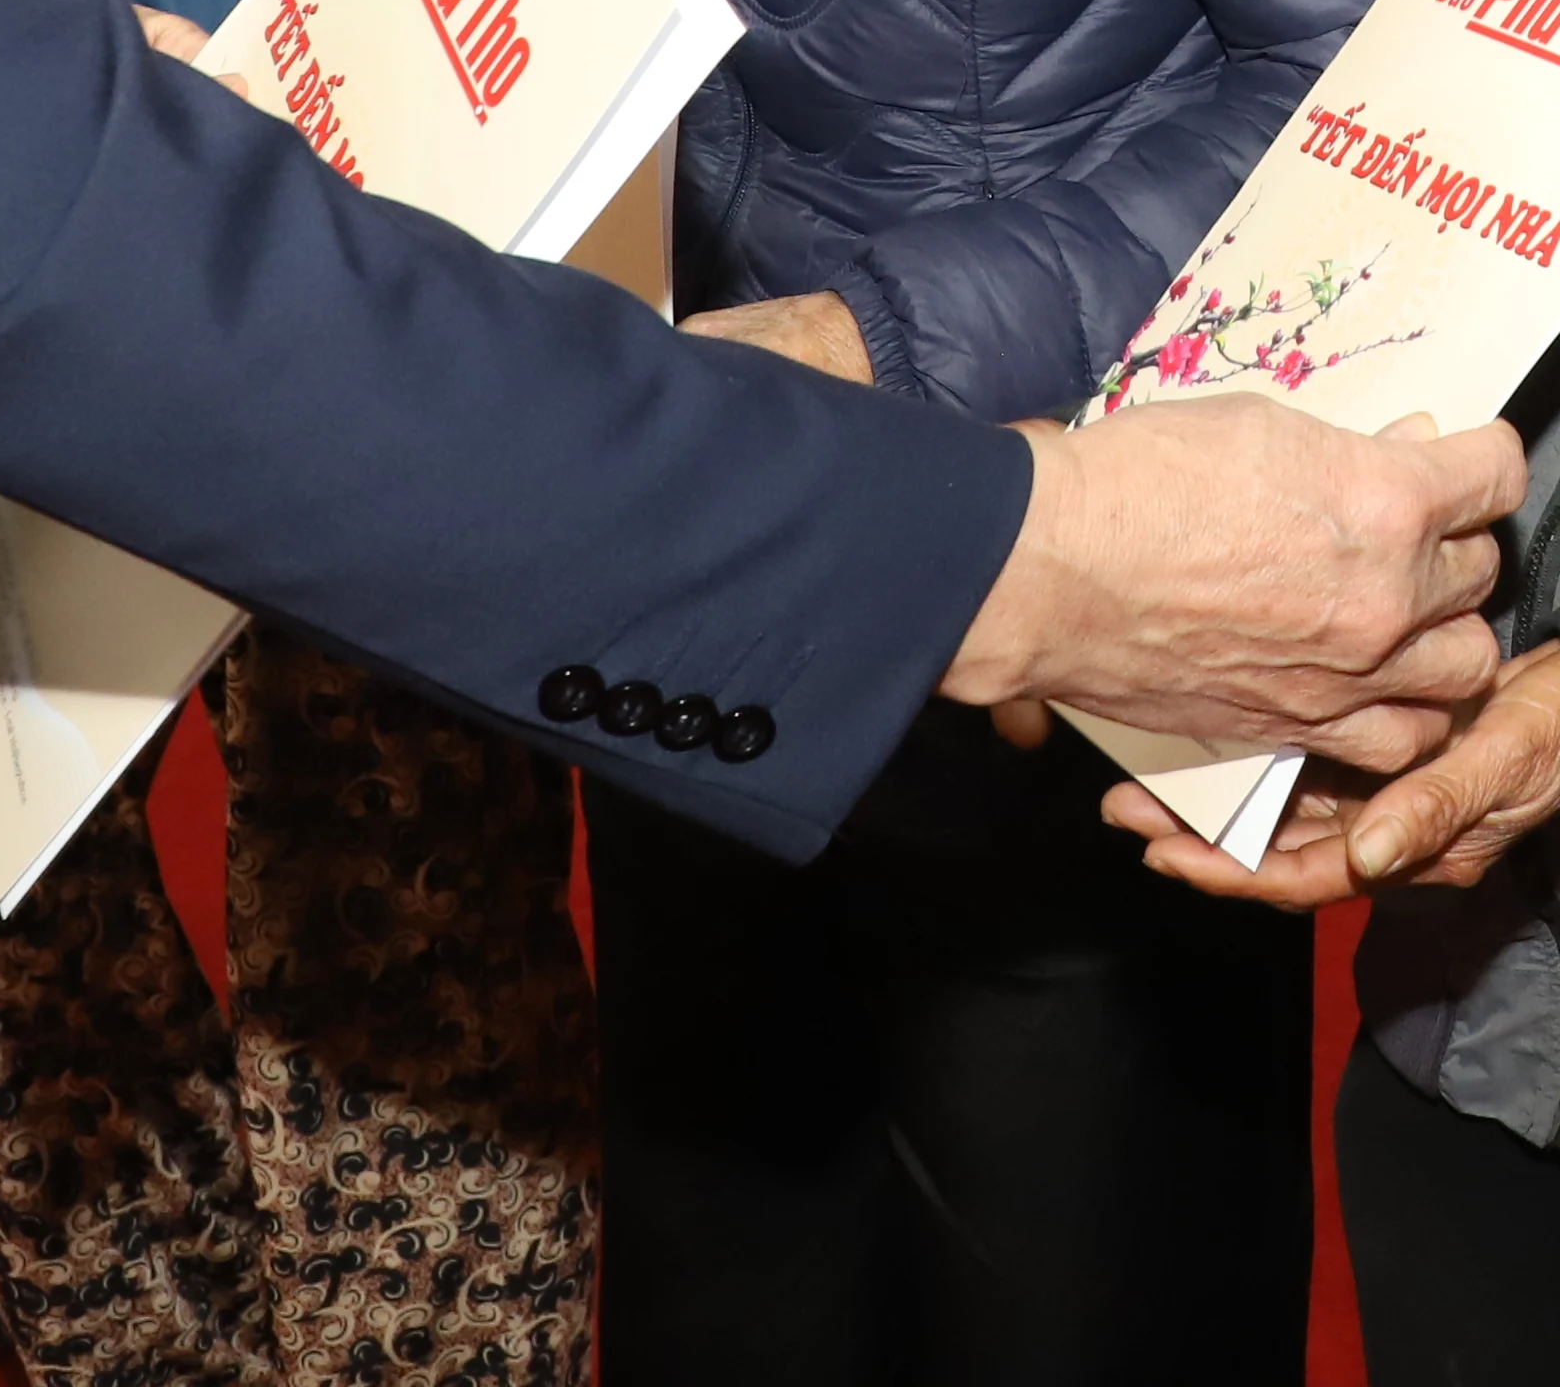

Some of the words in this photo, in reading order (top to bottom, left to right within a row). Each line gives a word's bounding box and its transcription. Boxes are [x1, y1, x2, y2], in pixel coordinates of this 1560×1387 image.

[286, 57, 345, 156] ĐẾN
[1351, 128, 1433, 199] ĐẾN
[1415, 163, 1496, 234] MỌI
